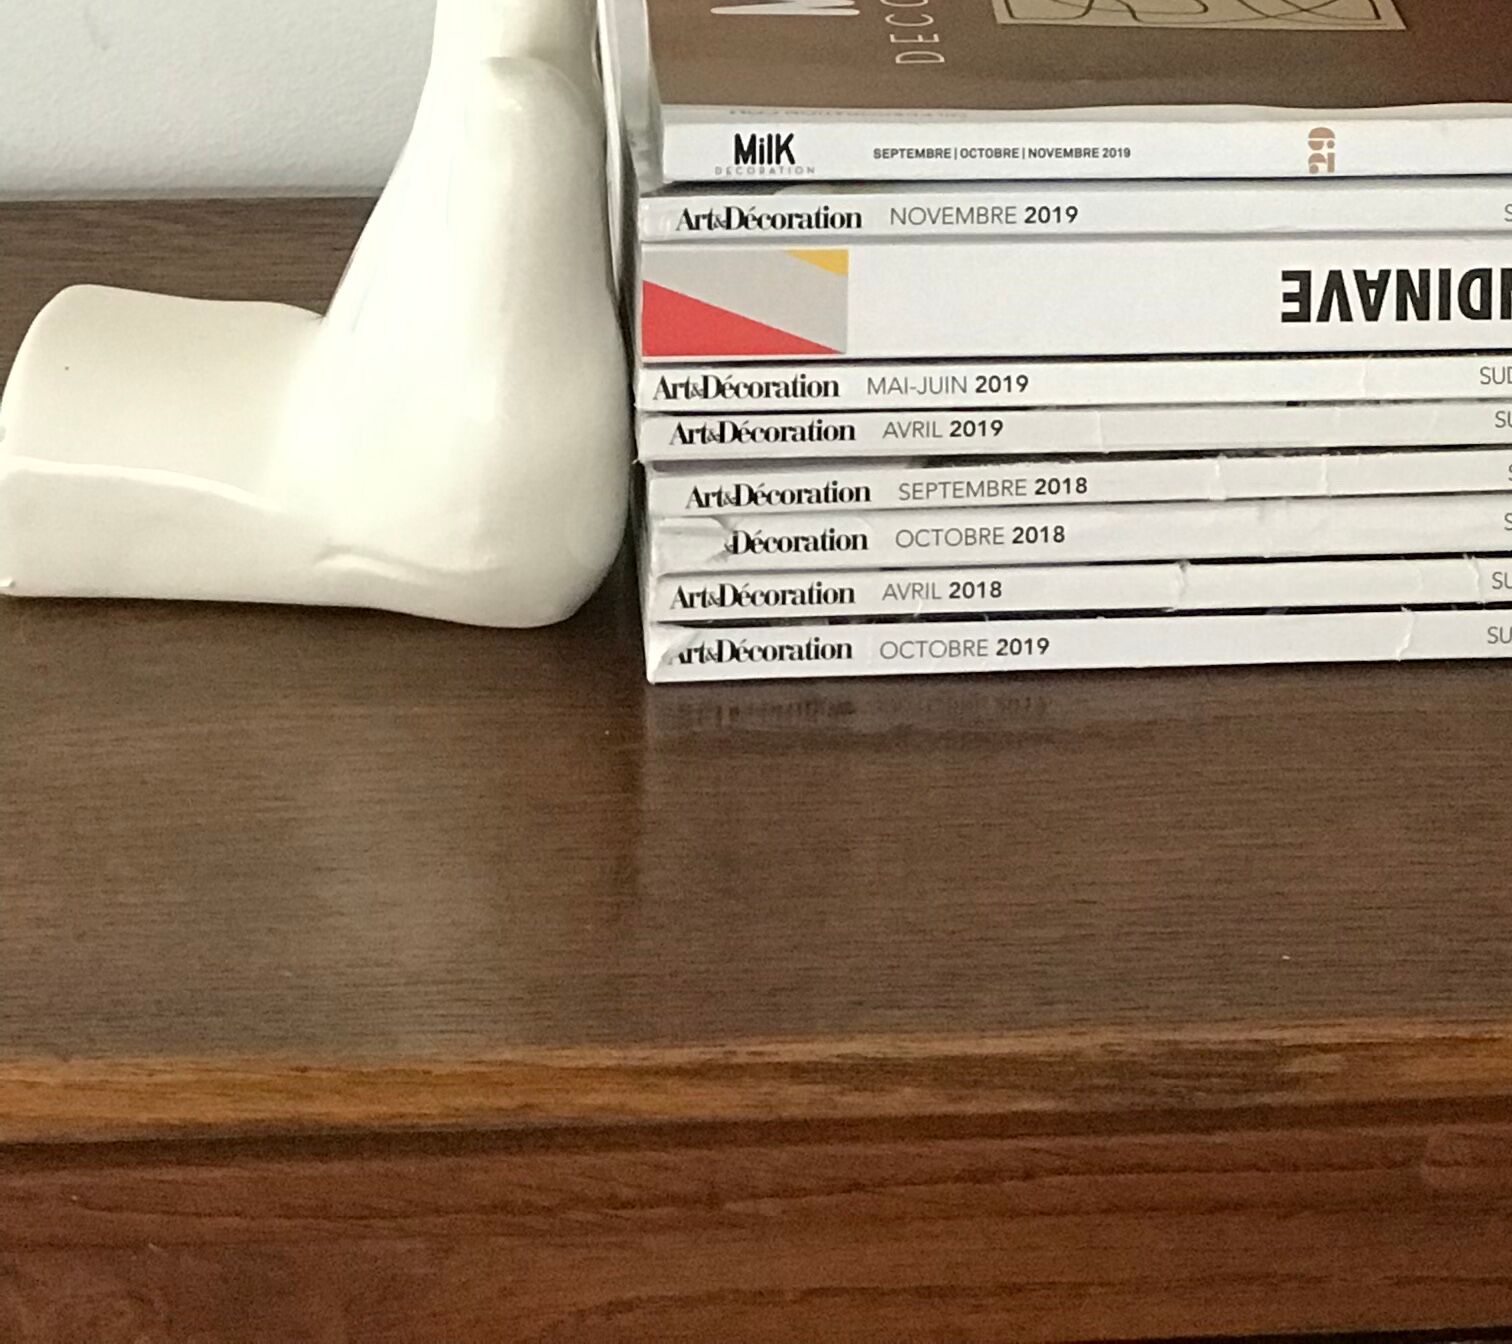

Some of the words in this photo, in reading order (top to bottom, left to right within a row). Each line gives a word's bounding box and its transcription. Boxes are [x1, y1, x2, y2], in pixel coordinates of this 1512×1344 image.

[734, 133, 796, 165] MilK
[873, 148, 951, 159] SEPTEMBRE
[960, 147, 1019, 159] OCTOBRE
[1028, 147, 1099, 159] NOVEMBRE
[1102, 147, 1131, 159] 2019
[715, 166, 816, 175] DECORATION
[890, 206, 1017, 225] NOVEMBRE
[1024, 205, 1078, 224] 2019
[867, 375, 968, 396] MAI-JUIN
[975, 375, 1029, 394] 2019
[882, 420, 943, 439] AVRIL
[950, 419, 1003, 438] 2019
[898, 479, 1027, 501] SEPTEMBRE
[1034, 477, 1088, 496] 2018
[895, 528, 1005, 548] OCTOBRE
[1012, 525, 1065, 545] 2018
[882, 583, 941, 602] AVRIL
[949, 581, 1002, 600] 2018
[880, 639, 989, 660] OCTOBRE
[996, 637, 1050, 656] 2019
